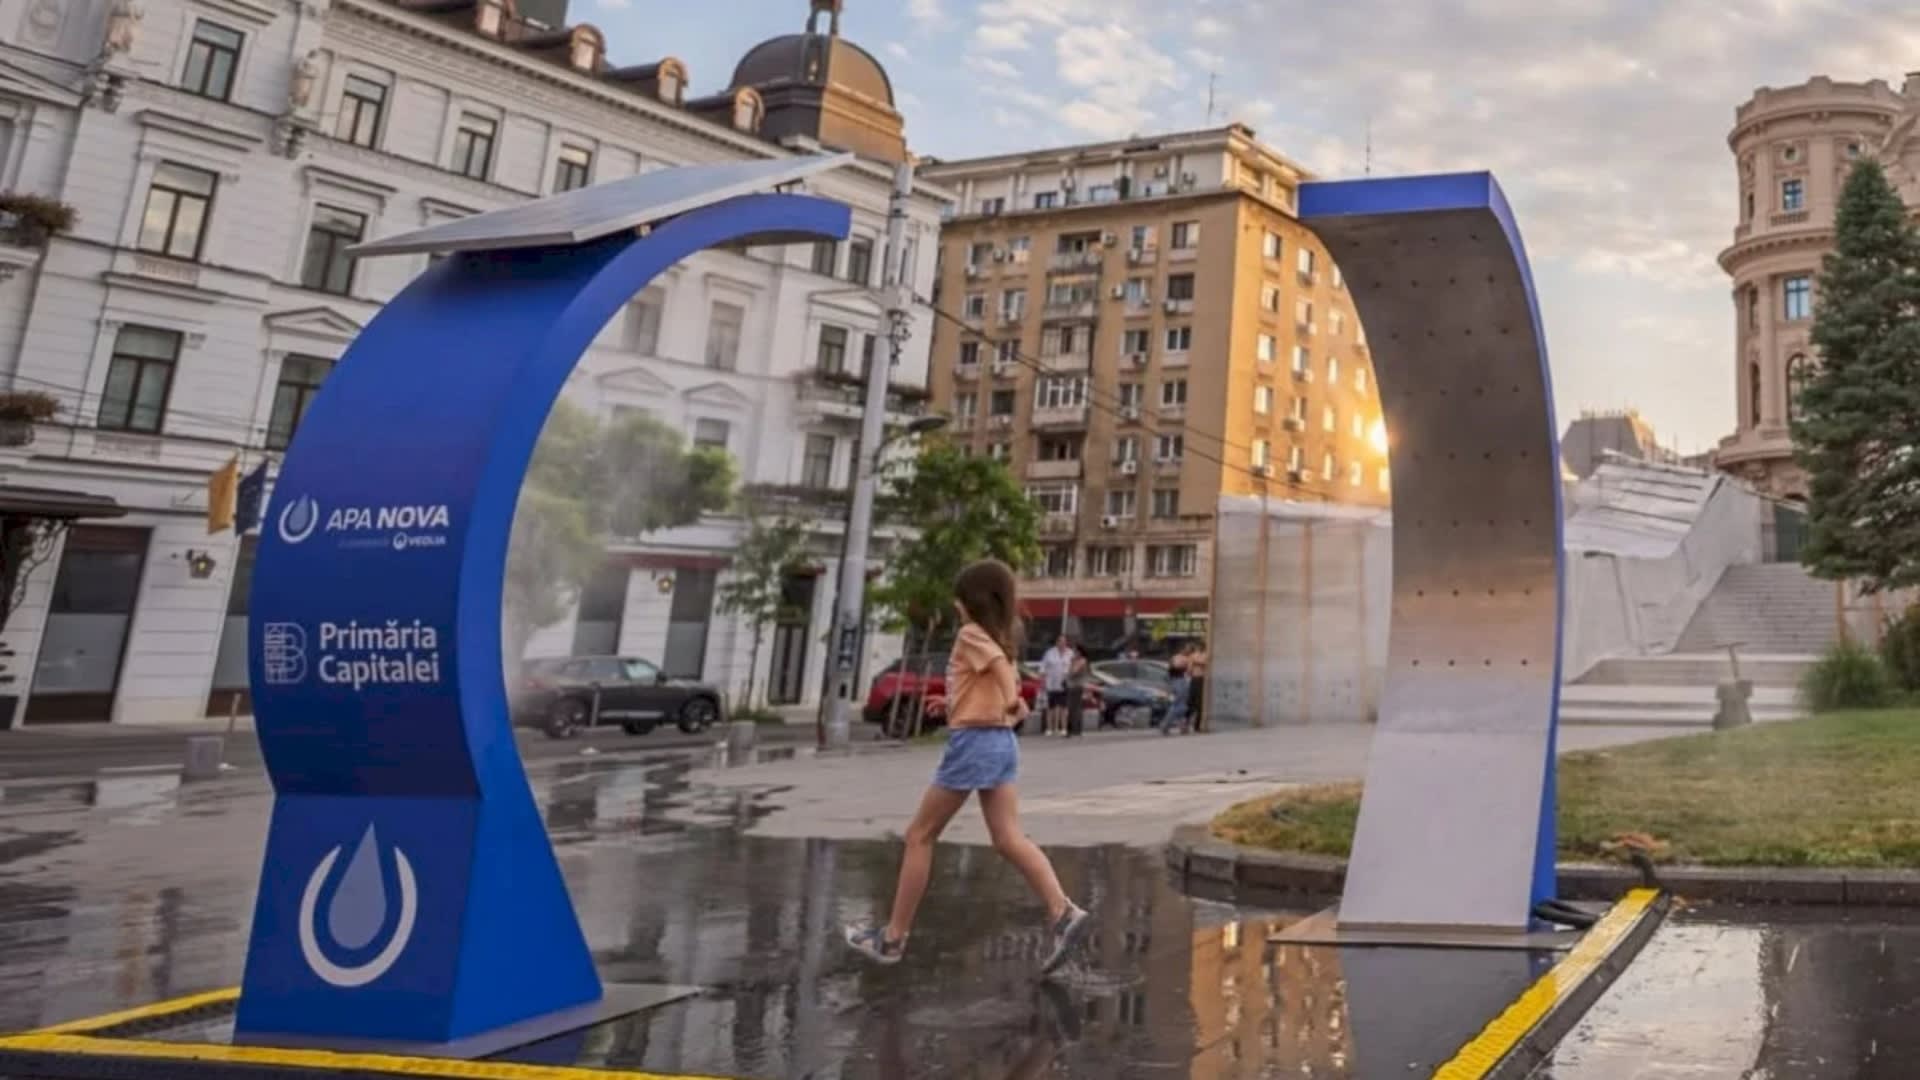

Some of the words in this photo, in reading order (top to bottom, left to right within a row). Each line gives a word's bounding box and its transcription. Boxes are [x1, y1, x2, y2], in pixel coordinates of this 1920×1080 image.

[325, 507, 372, 531] APA
[376, 504, 449, 529] NOVA
[408, 535, 447, 547] VEOLIA
[320, 619, 437, 650] Primăria
[319, 652, 439, 691] Capitalei
